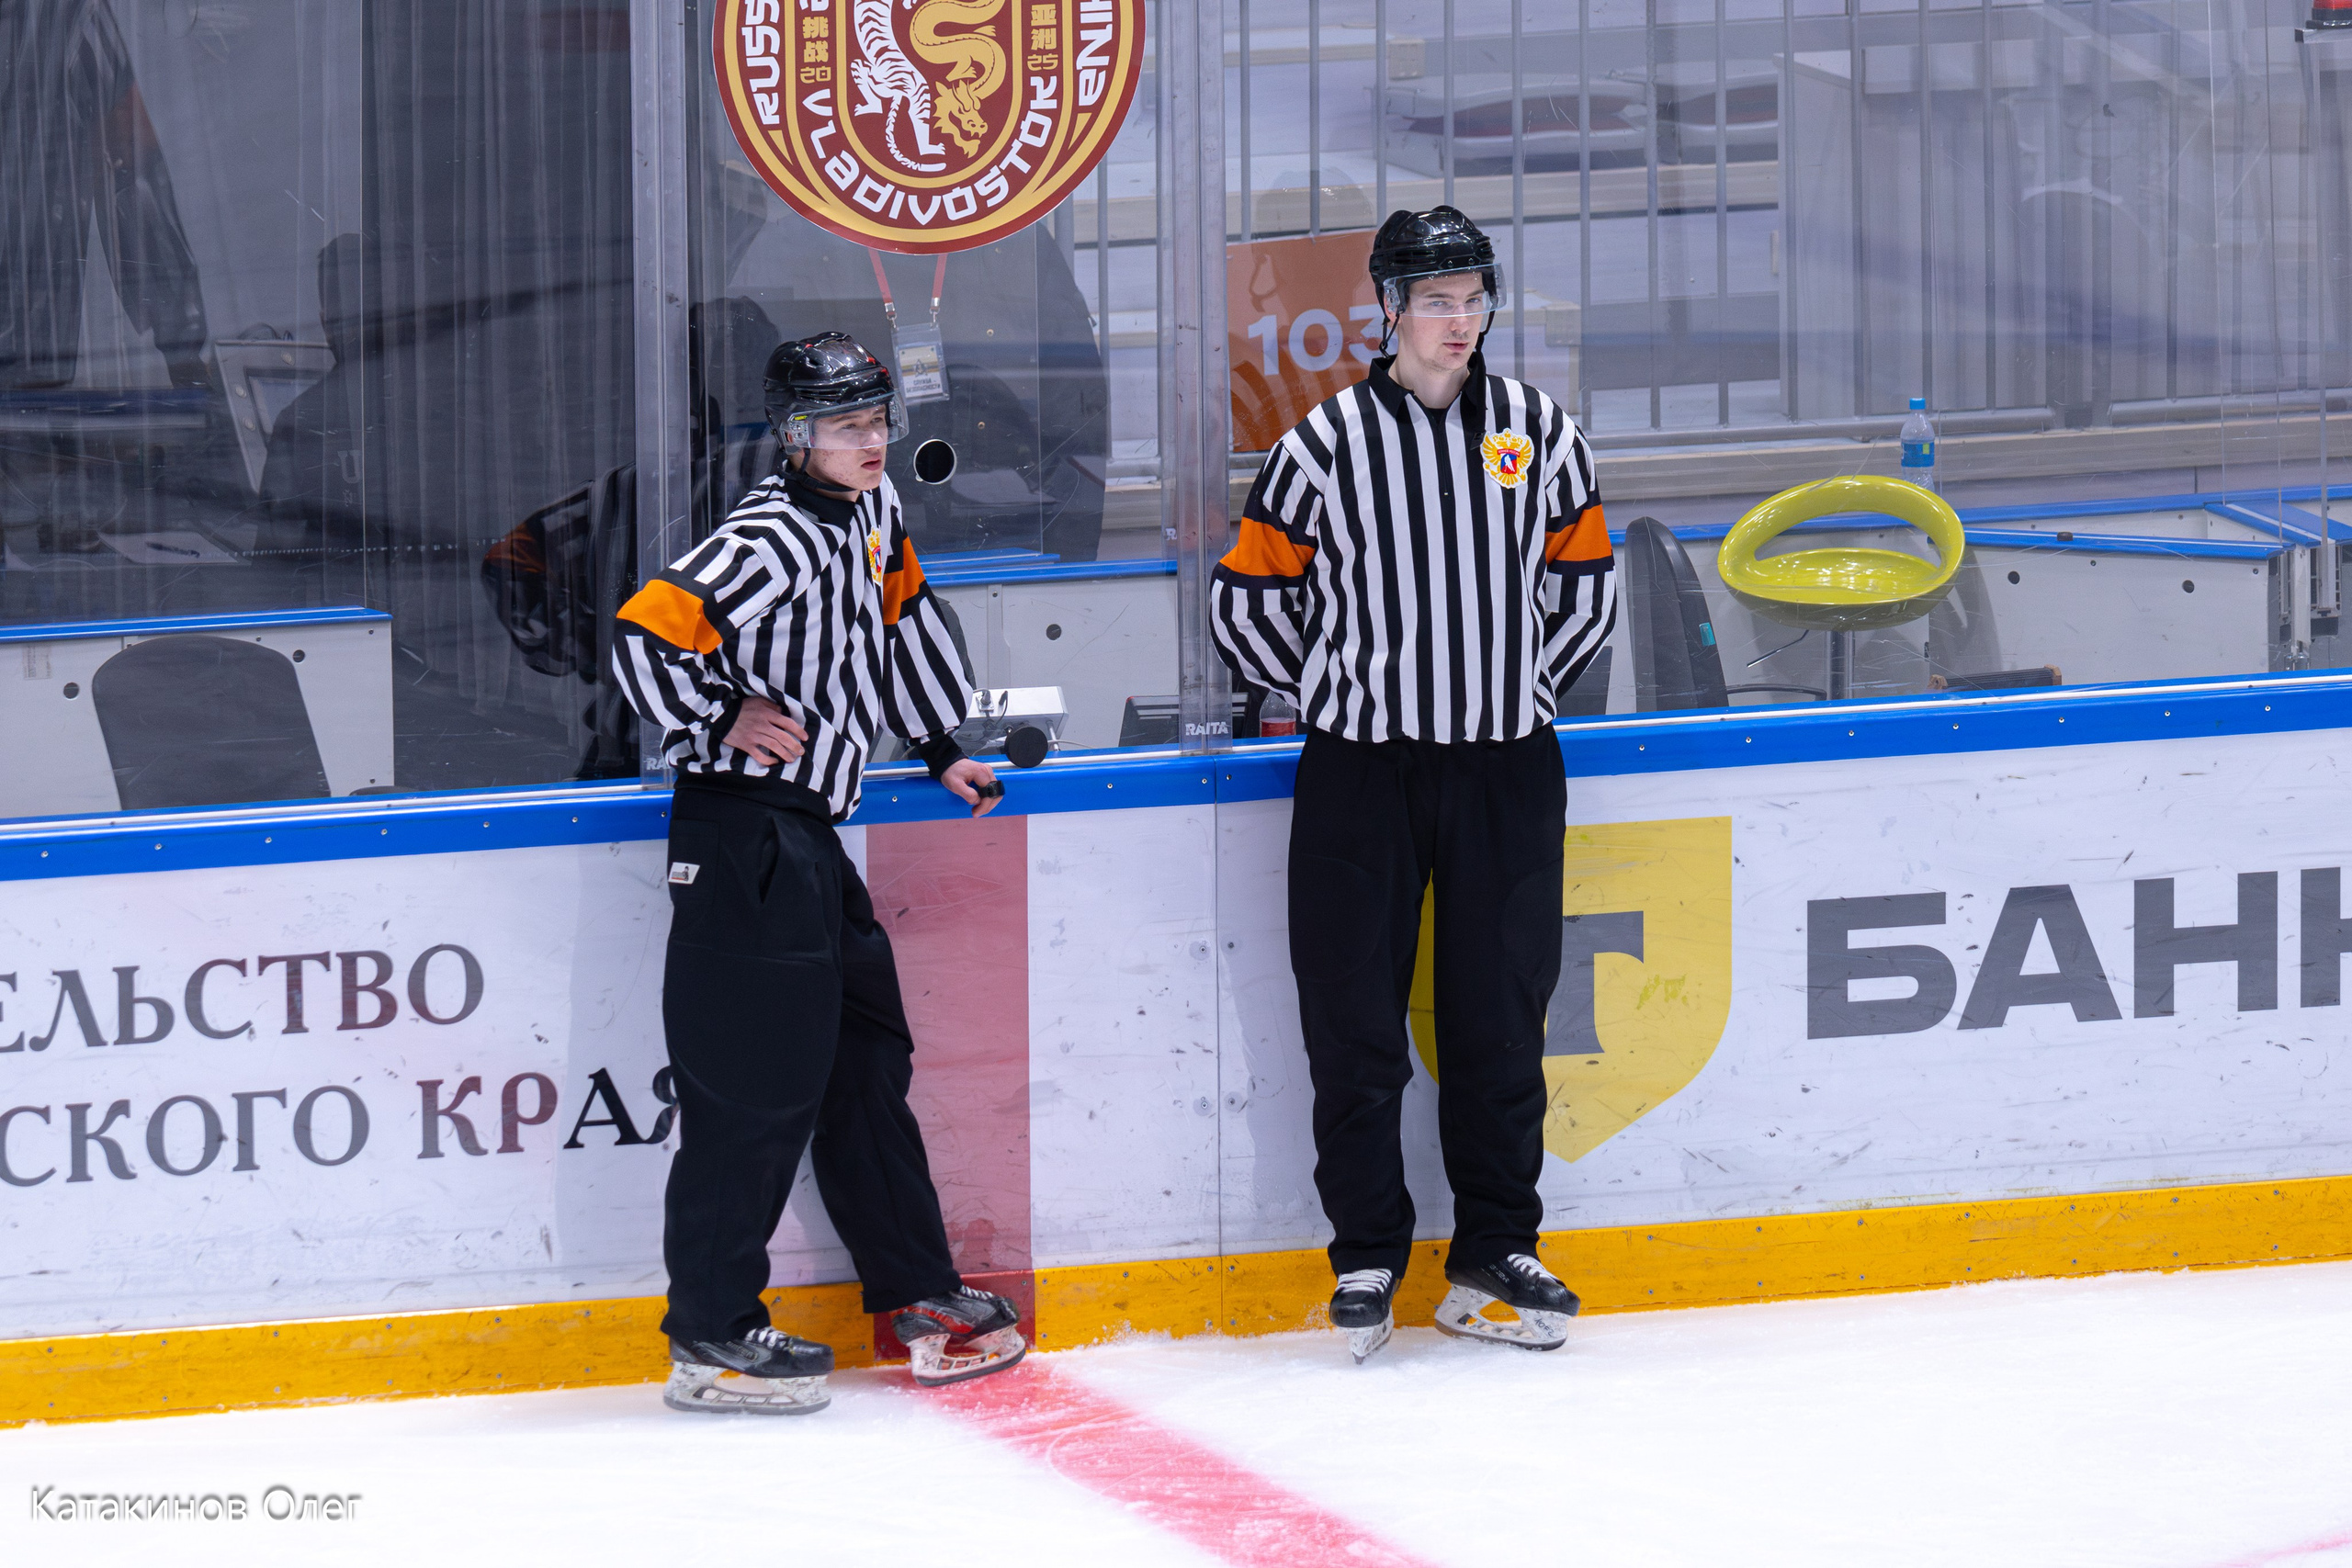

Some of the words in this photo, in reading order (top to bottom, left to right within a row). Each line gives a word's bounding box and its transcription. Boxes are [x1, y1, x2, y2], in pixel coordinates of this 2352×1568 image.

[1248, 304, 1398, 377] 103
[1185, 721, 1228, 736] RAITA
[0, 1085, 371, 1187] СКОГО
